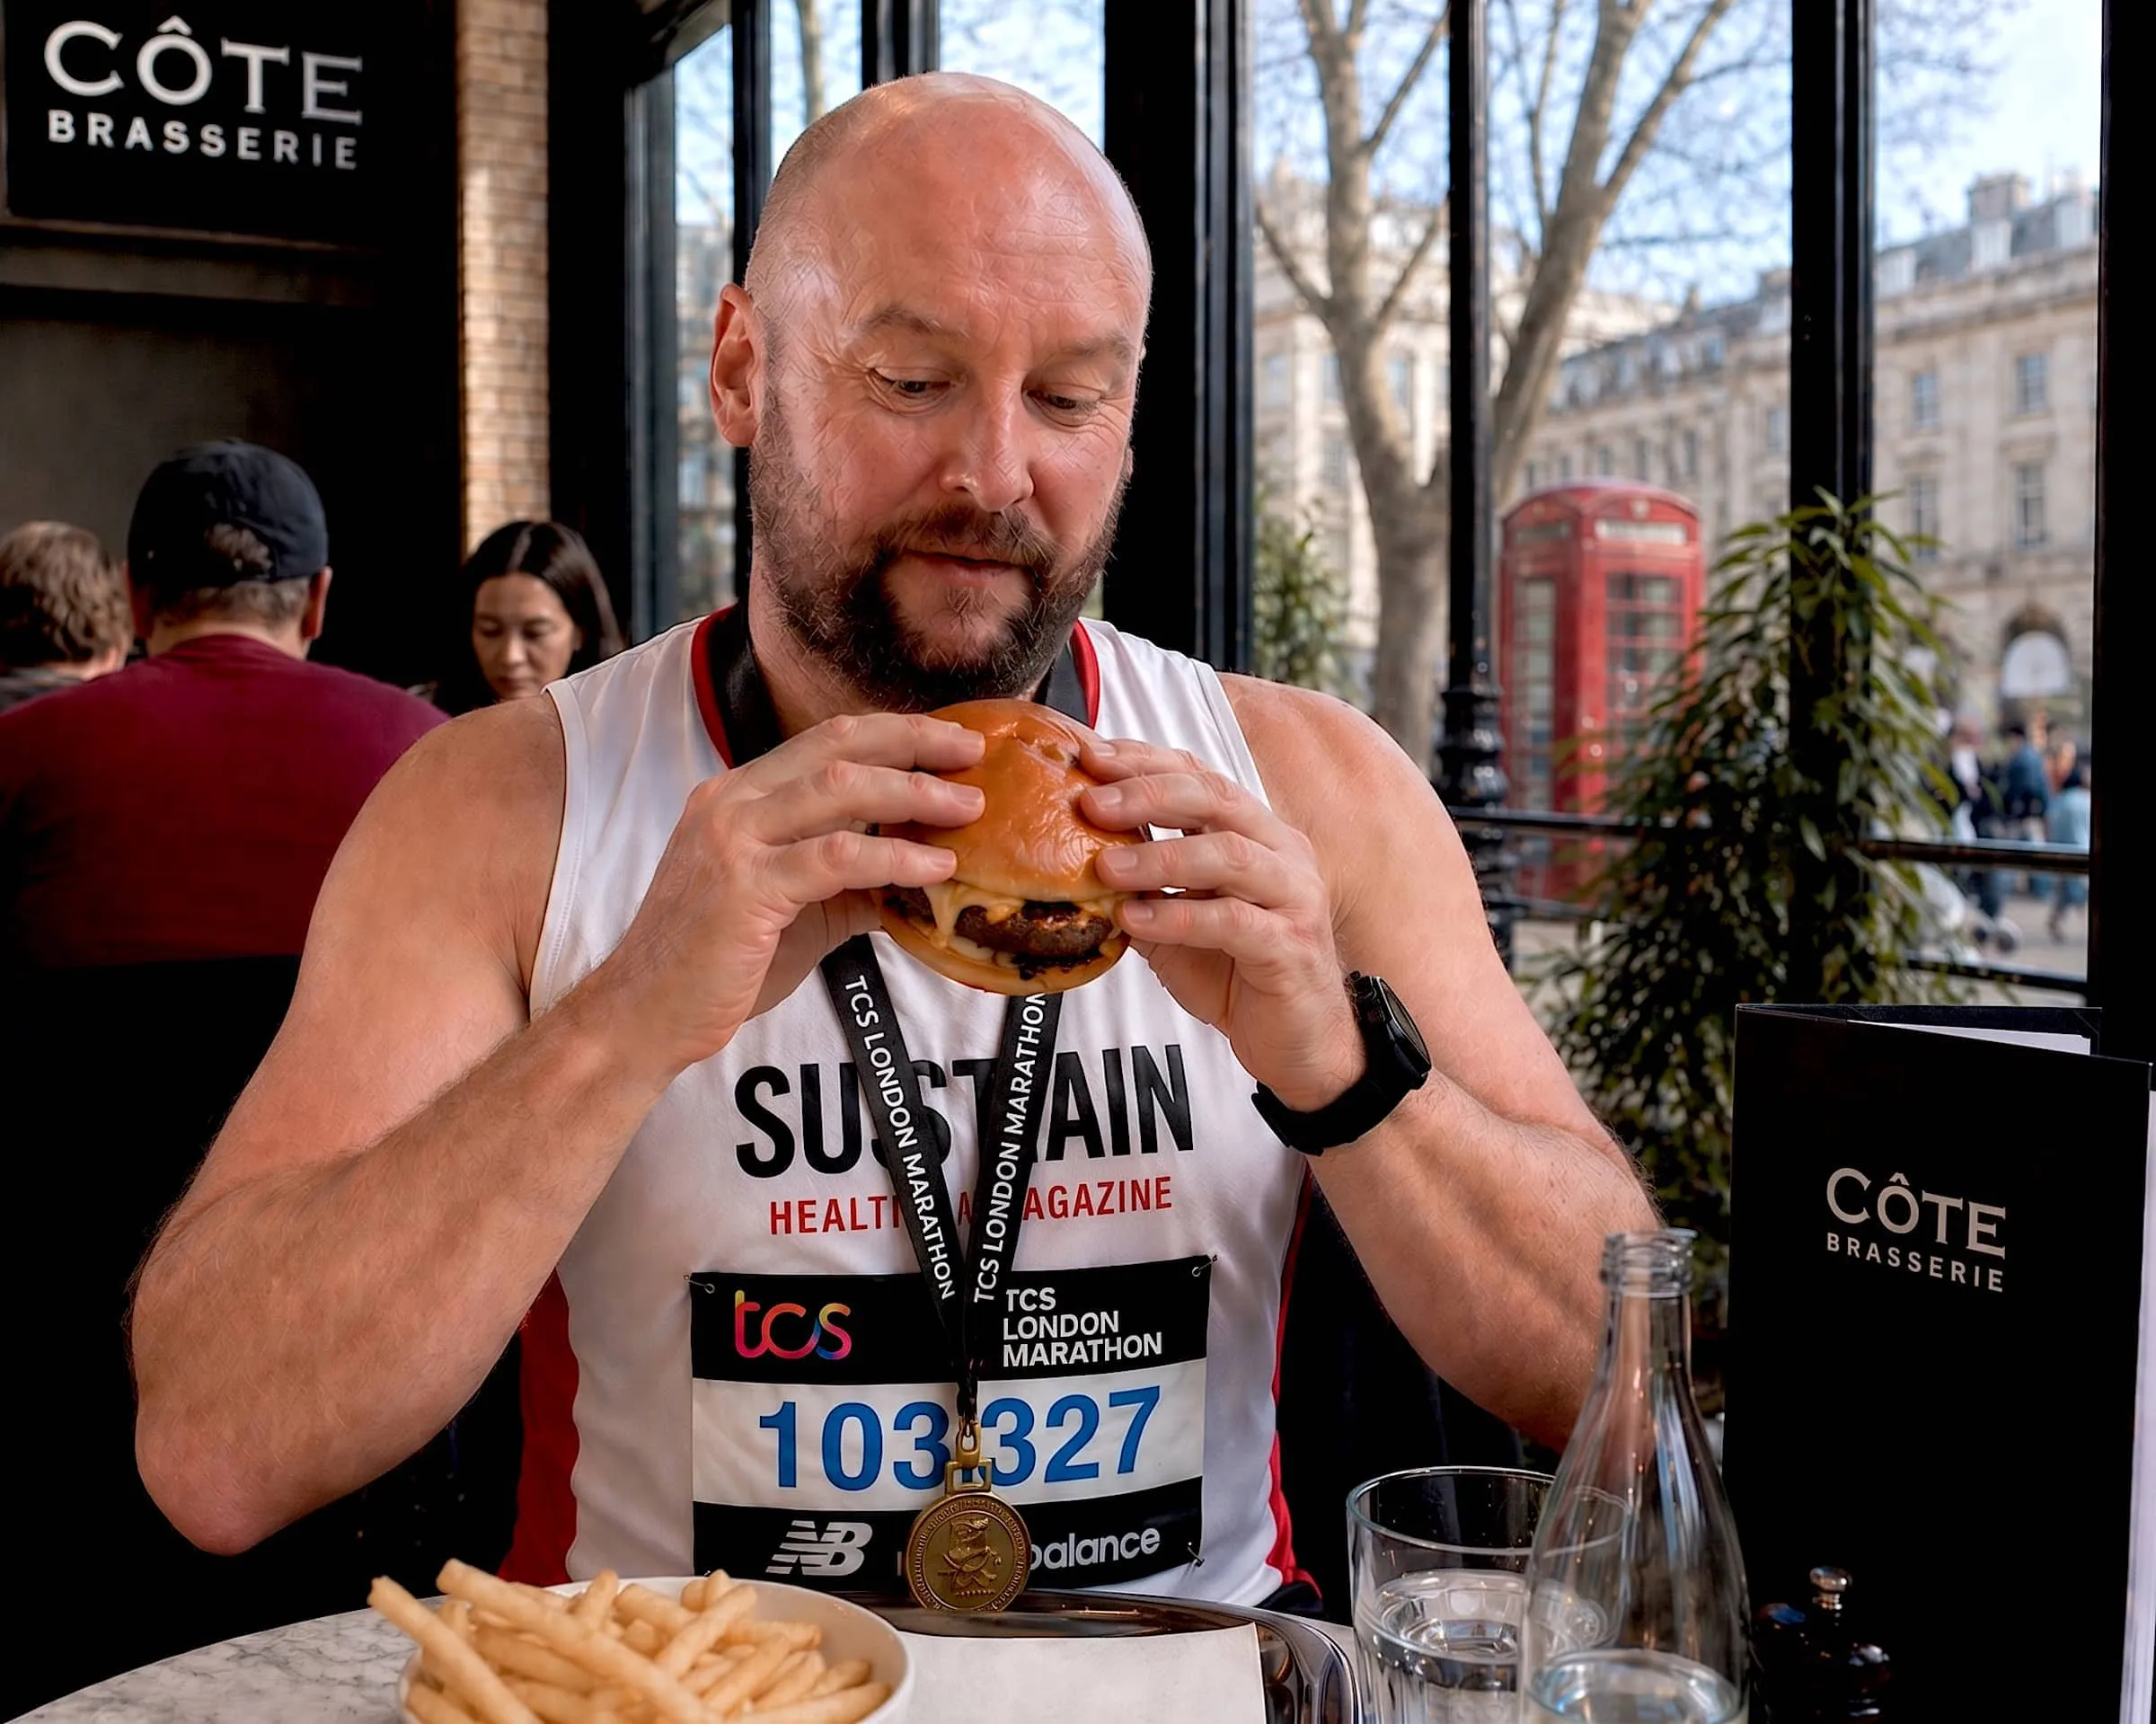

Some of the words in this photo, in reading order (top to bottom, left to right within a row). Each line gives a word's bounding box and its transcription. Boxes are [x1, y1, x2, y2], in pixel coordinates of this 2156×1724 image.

[45, 16, 362, 124] CÔTE
[49, 109, 356, 169] BRASSERIE
[1003, 993, 1047, 1136] MARATHON
[845, 975, 879, 1028] TCS
[863, 1032, 918, 1148] LONDON
[903, 1153, 956, 1299] MARATHON
[983, 1142, 1021, 1251] LONDON
[1023, 1176, 1172, 1220] AGAZINE
[1826, 1167, 2006, 1260] CÔTE
[974, 1258, 1000, 1303] TCS
[1827, 1232, 2003, 1293] BRASSERIE
[734, 1289, 853, 1360] tcs
[1003, 1310, 1119, 1341] LONDON
[1006, 1287, 1056, 1313] TCS
[1003, 1331, 1162, 1367] MARATHON
